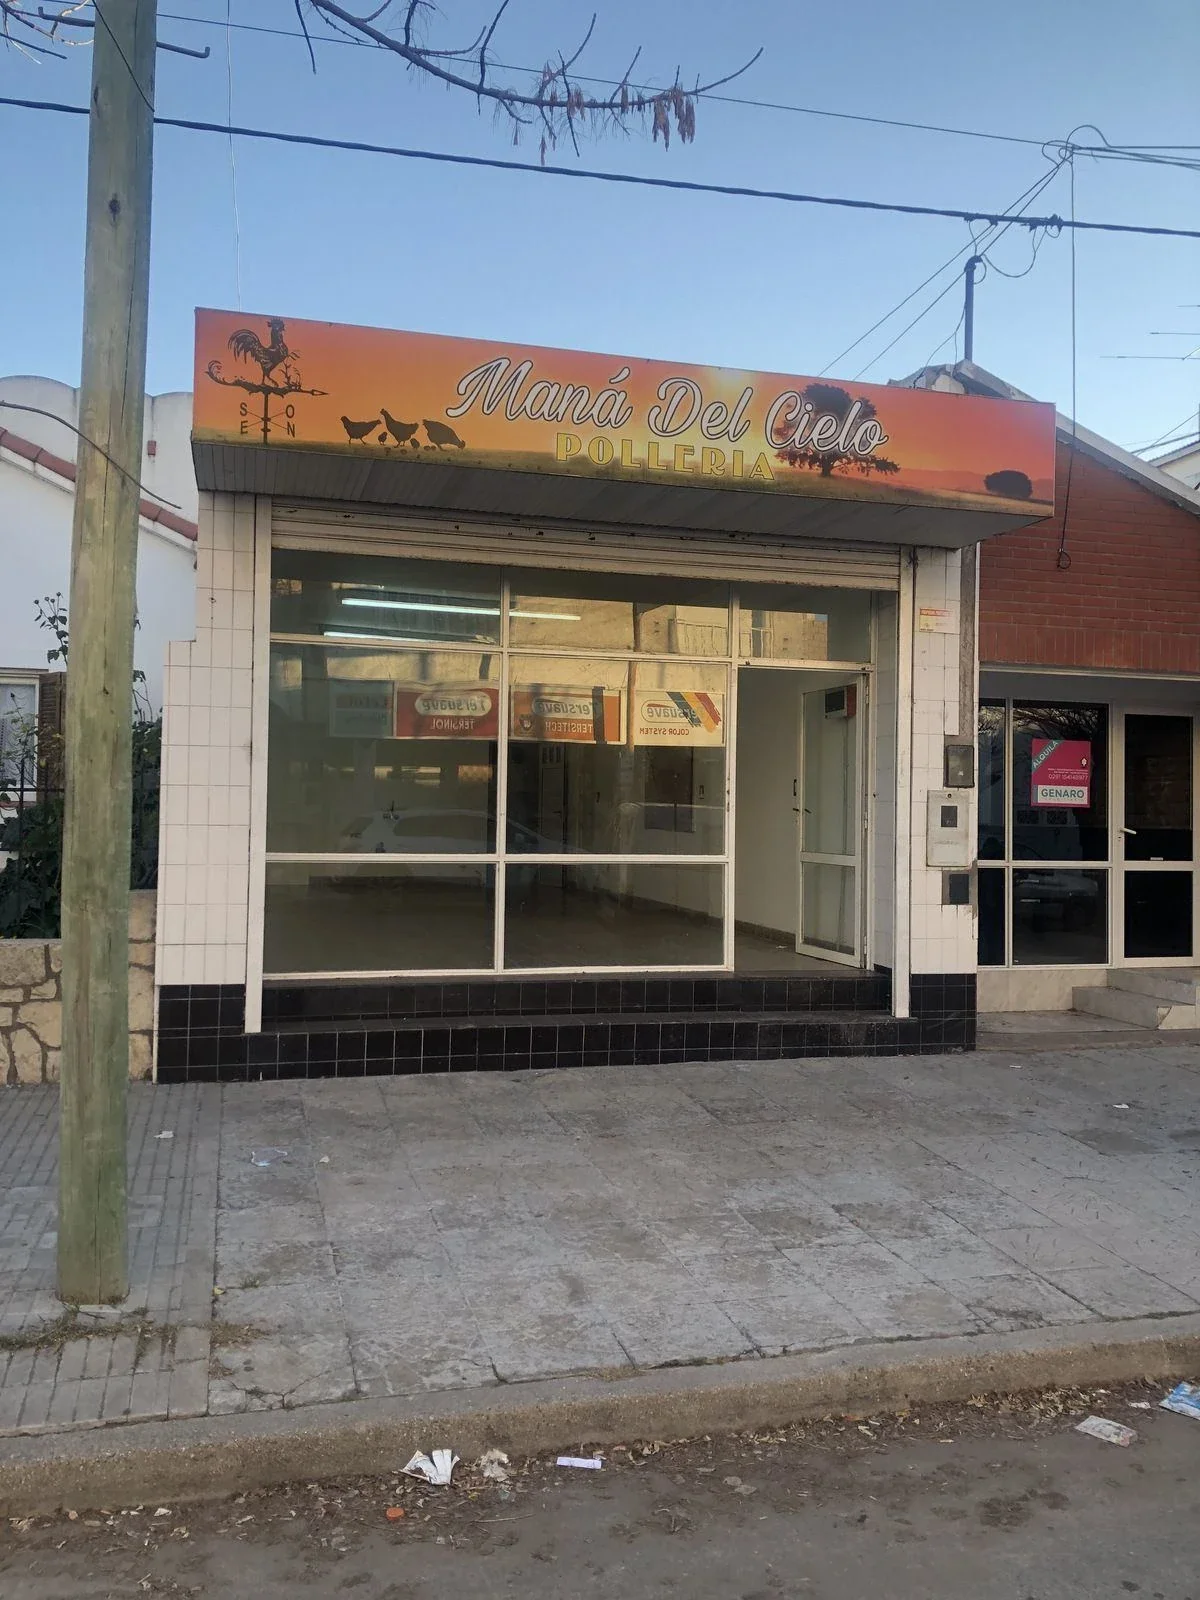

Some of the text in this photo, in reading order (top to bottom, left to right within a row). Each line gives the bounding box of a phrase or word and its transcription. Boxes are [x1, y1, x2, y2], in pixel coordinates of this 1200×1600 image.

[240, 402, 248, 417] S
[285, 404, 295, 419] O
[445, 356, 890, 456] Maná Del Cielo
[240, 420, 249, 435] E
[287, 421, 296, 438] N
[556, 432, 775, 481] POLLERIA
[1032, 740, 1059, 769] ALQUILA
[1041, 788, 1085, 799] GENARO
